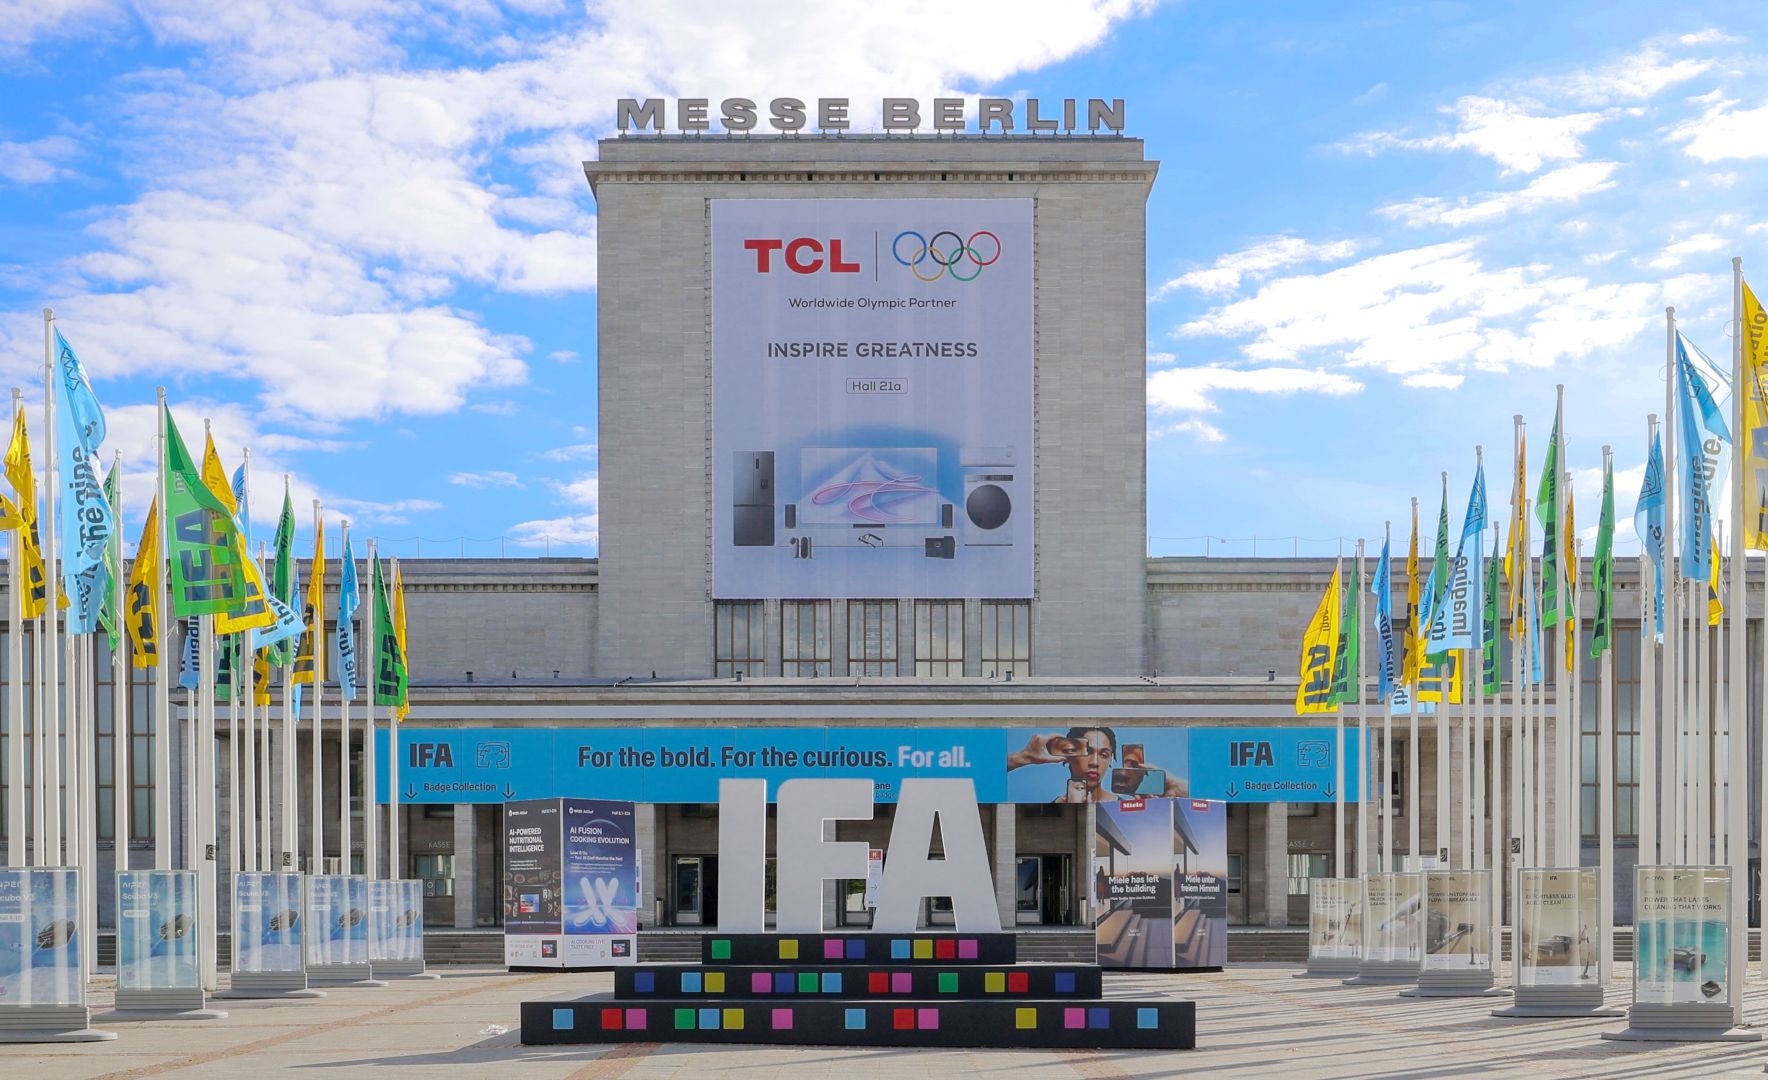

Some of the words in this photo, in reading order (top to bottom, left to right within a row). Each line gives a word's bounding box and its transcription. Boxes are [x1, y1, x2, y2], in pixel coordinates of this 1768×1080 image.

[617, 98, 850, 130] MESSE
[882, 98, 1125, 130] BERLIN
[744, 238, 860, 273] TCL
[789, 297, 854, 309] Worldwide
[857, 297, 906, 311] Olympic
[908, 297, 957, 309] Partner
[768, 342, 848, 357] INSPIRE
[855, 342, 978, 357] GREATNESS
[852, 380, 876, 392] Hall
[879, 380, 902, 392] 21a
[175, 507, 233, 601] IFA
[410, 744, 453, 768] IFA
[578, 746, 614, 768] For
[618, 746, 655, 768] the
[660, 746, 715, 768] bold.
[721, 746, 756, 768] For
[762, 746, 798, 768] the
[803, 746, 892, 768] curious.
[898, 746, 936, 768] For
[939, 746, 971, 768] all.
[1230, 742, 1274, 767] IFA
[424, 782, 451, 793] Badge
[452, 782, 496, 792] Collection
[1245, 781, 1272, 792] Badge
[1274, 781, 1318, 790] Collection
[509, 836, 543, 844] NUTRITIONAL
[509, 844, 544, 852] INTELLIGENCE
[718, 778, 1000, 935] IFA
[1109, 876, 1130, 884] Miele
[1146, 875, 1160, 883] left
[1112, 885, 1124, 893] the
[1126, 884, 1156, 894] building
[1181, 884, 1198, 892] freiem
[1200, 884, 1220, 892] Himmel
